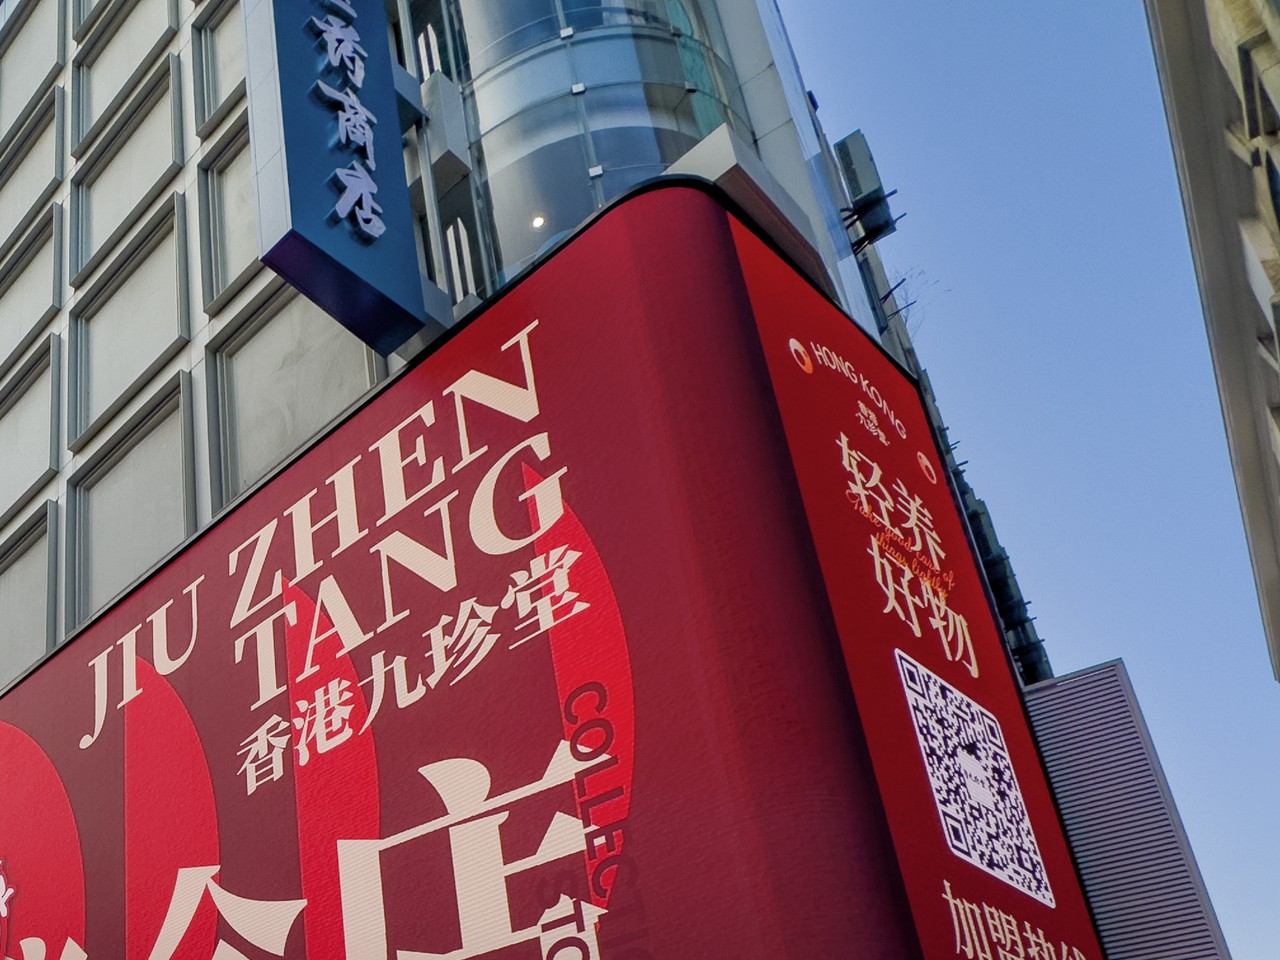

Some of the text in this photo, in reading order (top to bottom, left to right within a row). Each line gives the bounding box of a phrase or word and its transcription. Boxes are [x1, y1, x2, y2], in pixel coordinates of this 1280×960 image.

[810, 341, 907, 440] HONG KONG
[78, 318, 540, 750] JIU ZHEN
[233, 431, 569, 713] TANG
[835, 431, 946, 571] 轻养
[236, 543, 590, 797] 香港九珍堂
[867, 534, 979, 679] 好物
